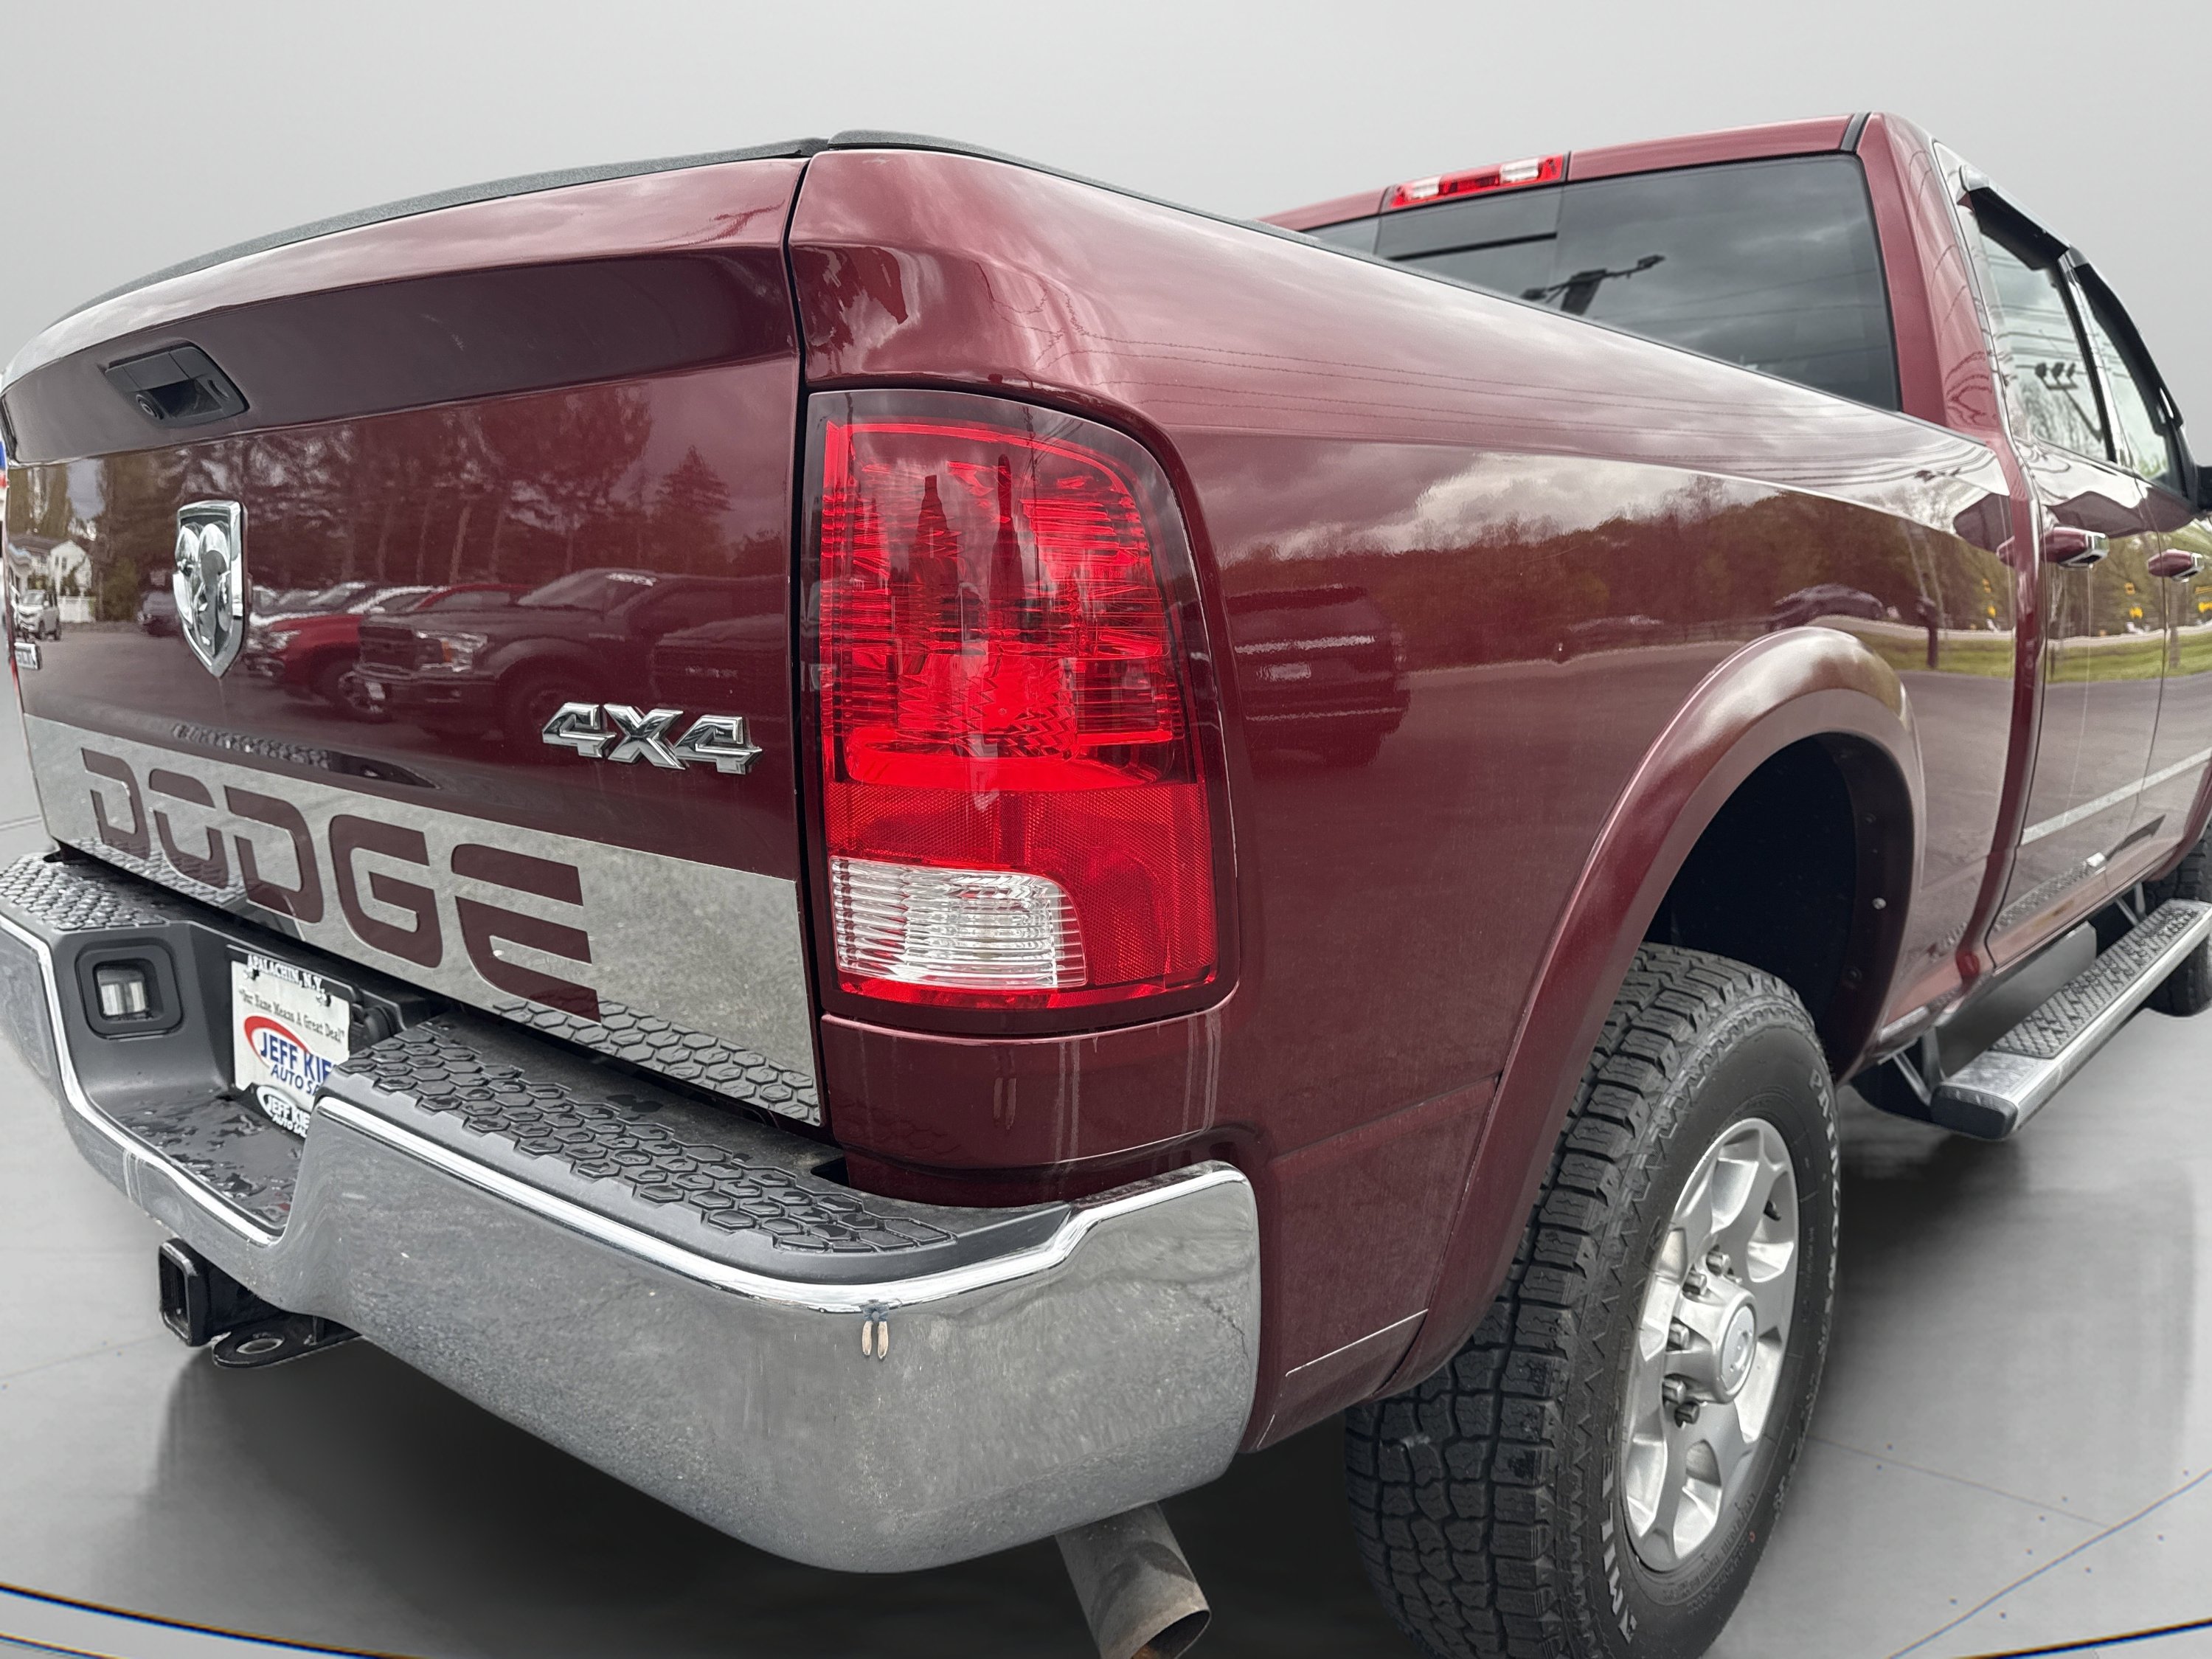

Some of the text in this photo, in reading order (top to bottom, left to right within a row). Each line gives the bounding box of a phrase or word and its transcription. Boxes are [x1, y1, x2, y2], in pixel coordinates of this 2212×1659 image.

[81, 747, 602, 1023] DODGE
[302, 973, 325, 993] N.Y.
[297, 1013, 302, 1026] A
[303, 1014, 323, 1035] Great
[260, 1032, 336, 1083] JEFF KIE
[271, 1064, 304, 1090] AUTO
[266, 1095, 291, 1118] JEFF
[271, 1114, 294, 1131] AUTO
